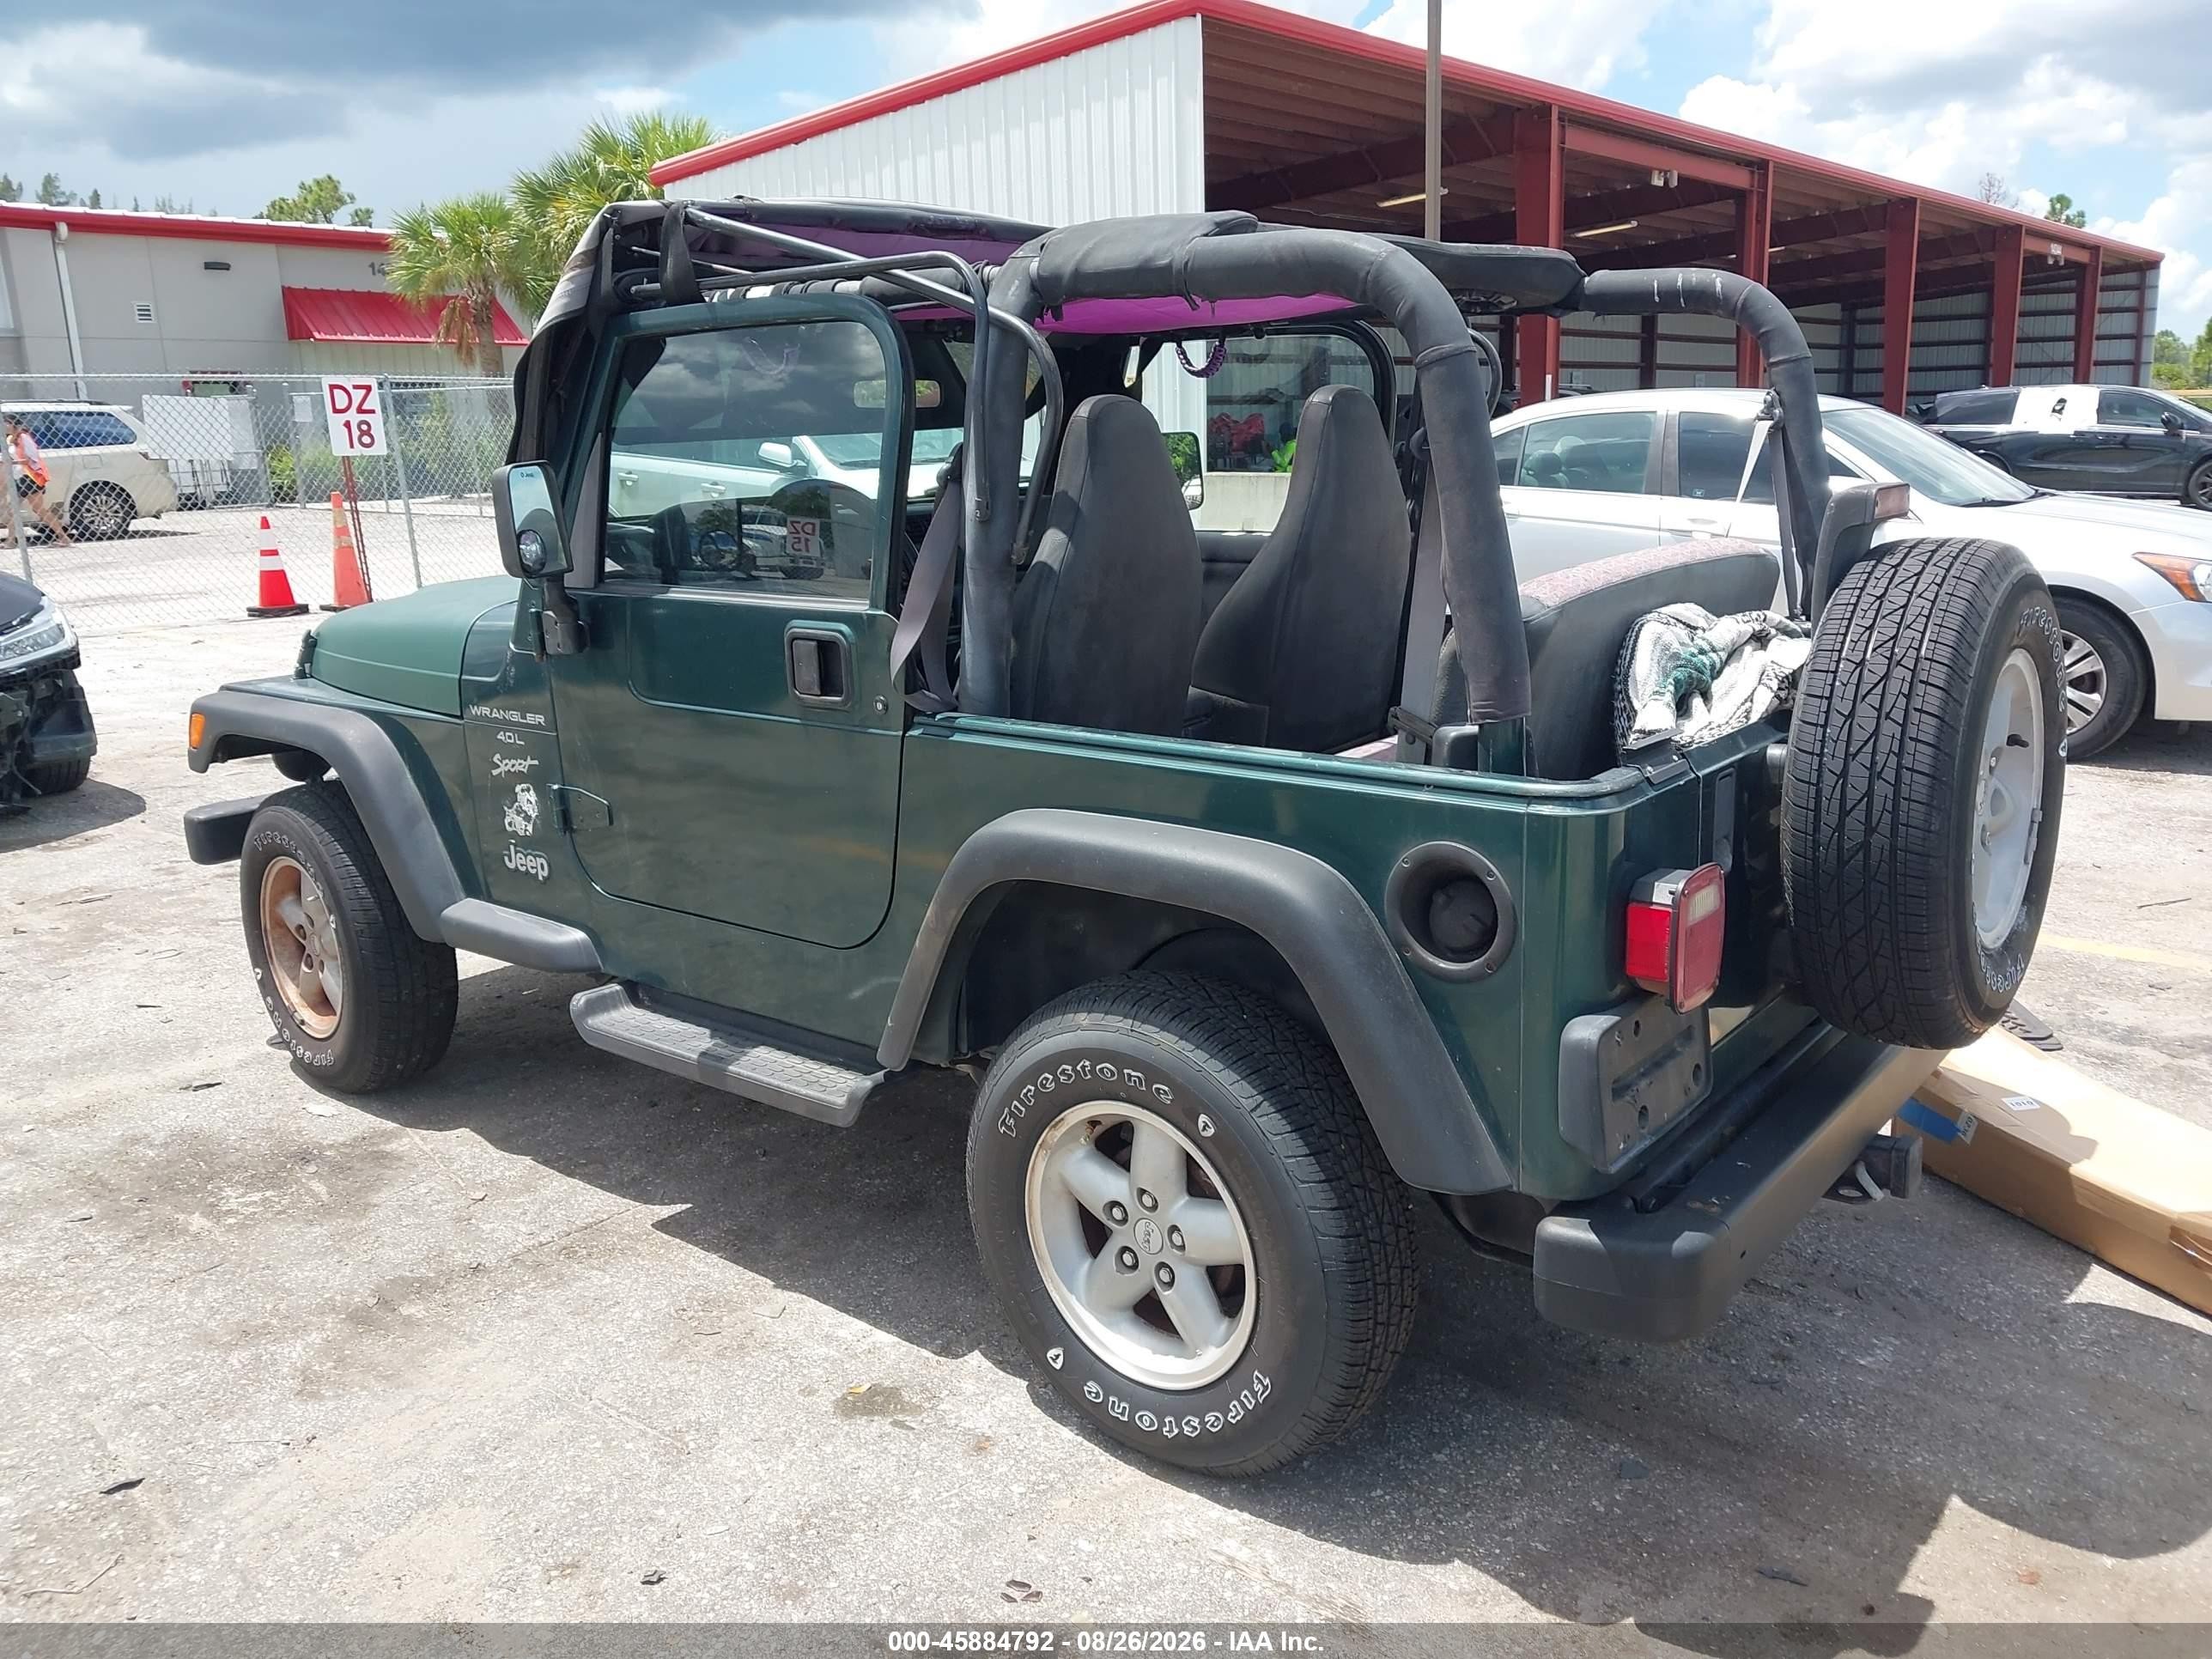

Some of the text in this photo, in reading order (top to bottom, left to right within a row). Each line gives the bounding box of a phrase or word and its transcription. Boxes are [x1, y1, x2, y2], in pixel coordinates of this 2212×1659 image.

[328, 383, 376, 415] DZ
[343, 419, 375, 449] 18
[469, 704, 546, 726] WRANGLER
[503, 838, 550, 882] Jeep
[997, 1058, 1174, 1138] Firestone
[1083, 1369, 1272, 1439] Firestone
